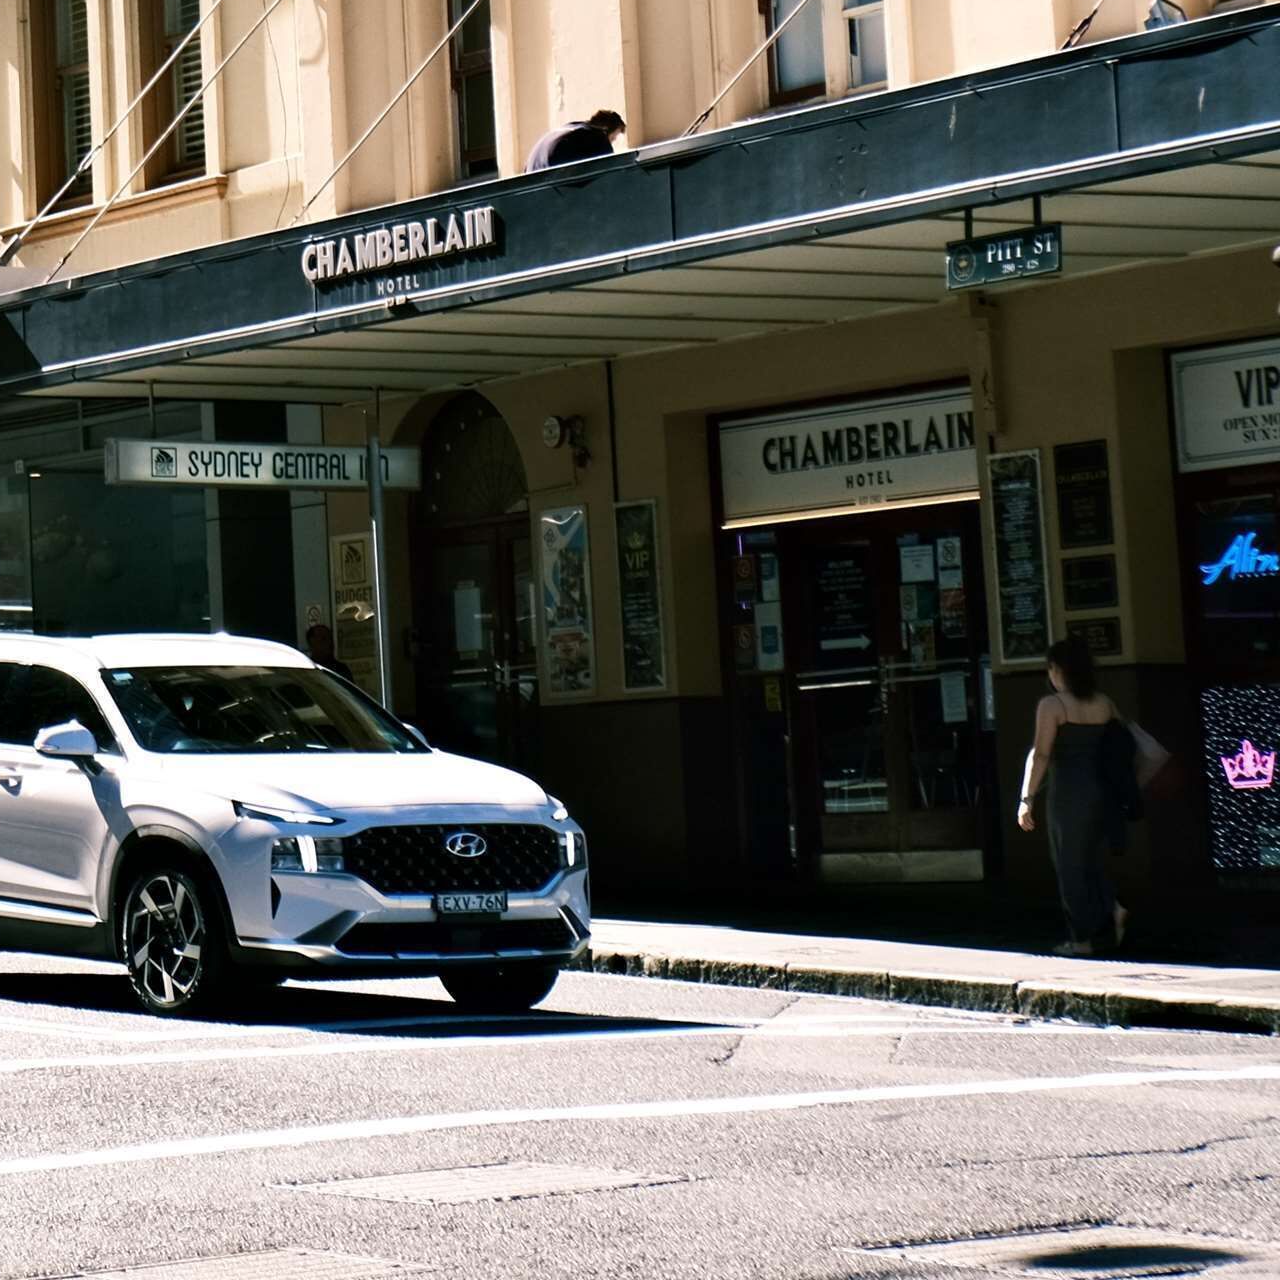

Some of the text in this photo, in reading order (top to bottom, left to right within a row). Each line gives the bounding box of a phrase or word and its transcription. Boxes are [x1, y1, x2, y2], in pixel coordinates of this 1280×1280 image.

[301, 206, 495, 281] CHAMBERLAIN
[985, 232, 1055, 264] PITT ST
[376, 274, 420, 296] HOTEL
[1234, 366, 1280, 408] VIP
[1223, 415, 1259, 431] OPEN
[762, 411, 976, 471] CHAMBERLAIN
[187, 450, 263, 479] SYDNEY
[272, 453, 351, 480] CENTRAL
[845, 470, 894, 489] HOTEL
[624, 551, 651, 570] VIP
[335, 586, 374, 604] BUDGET
